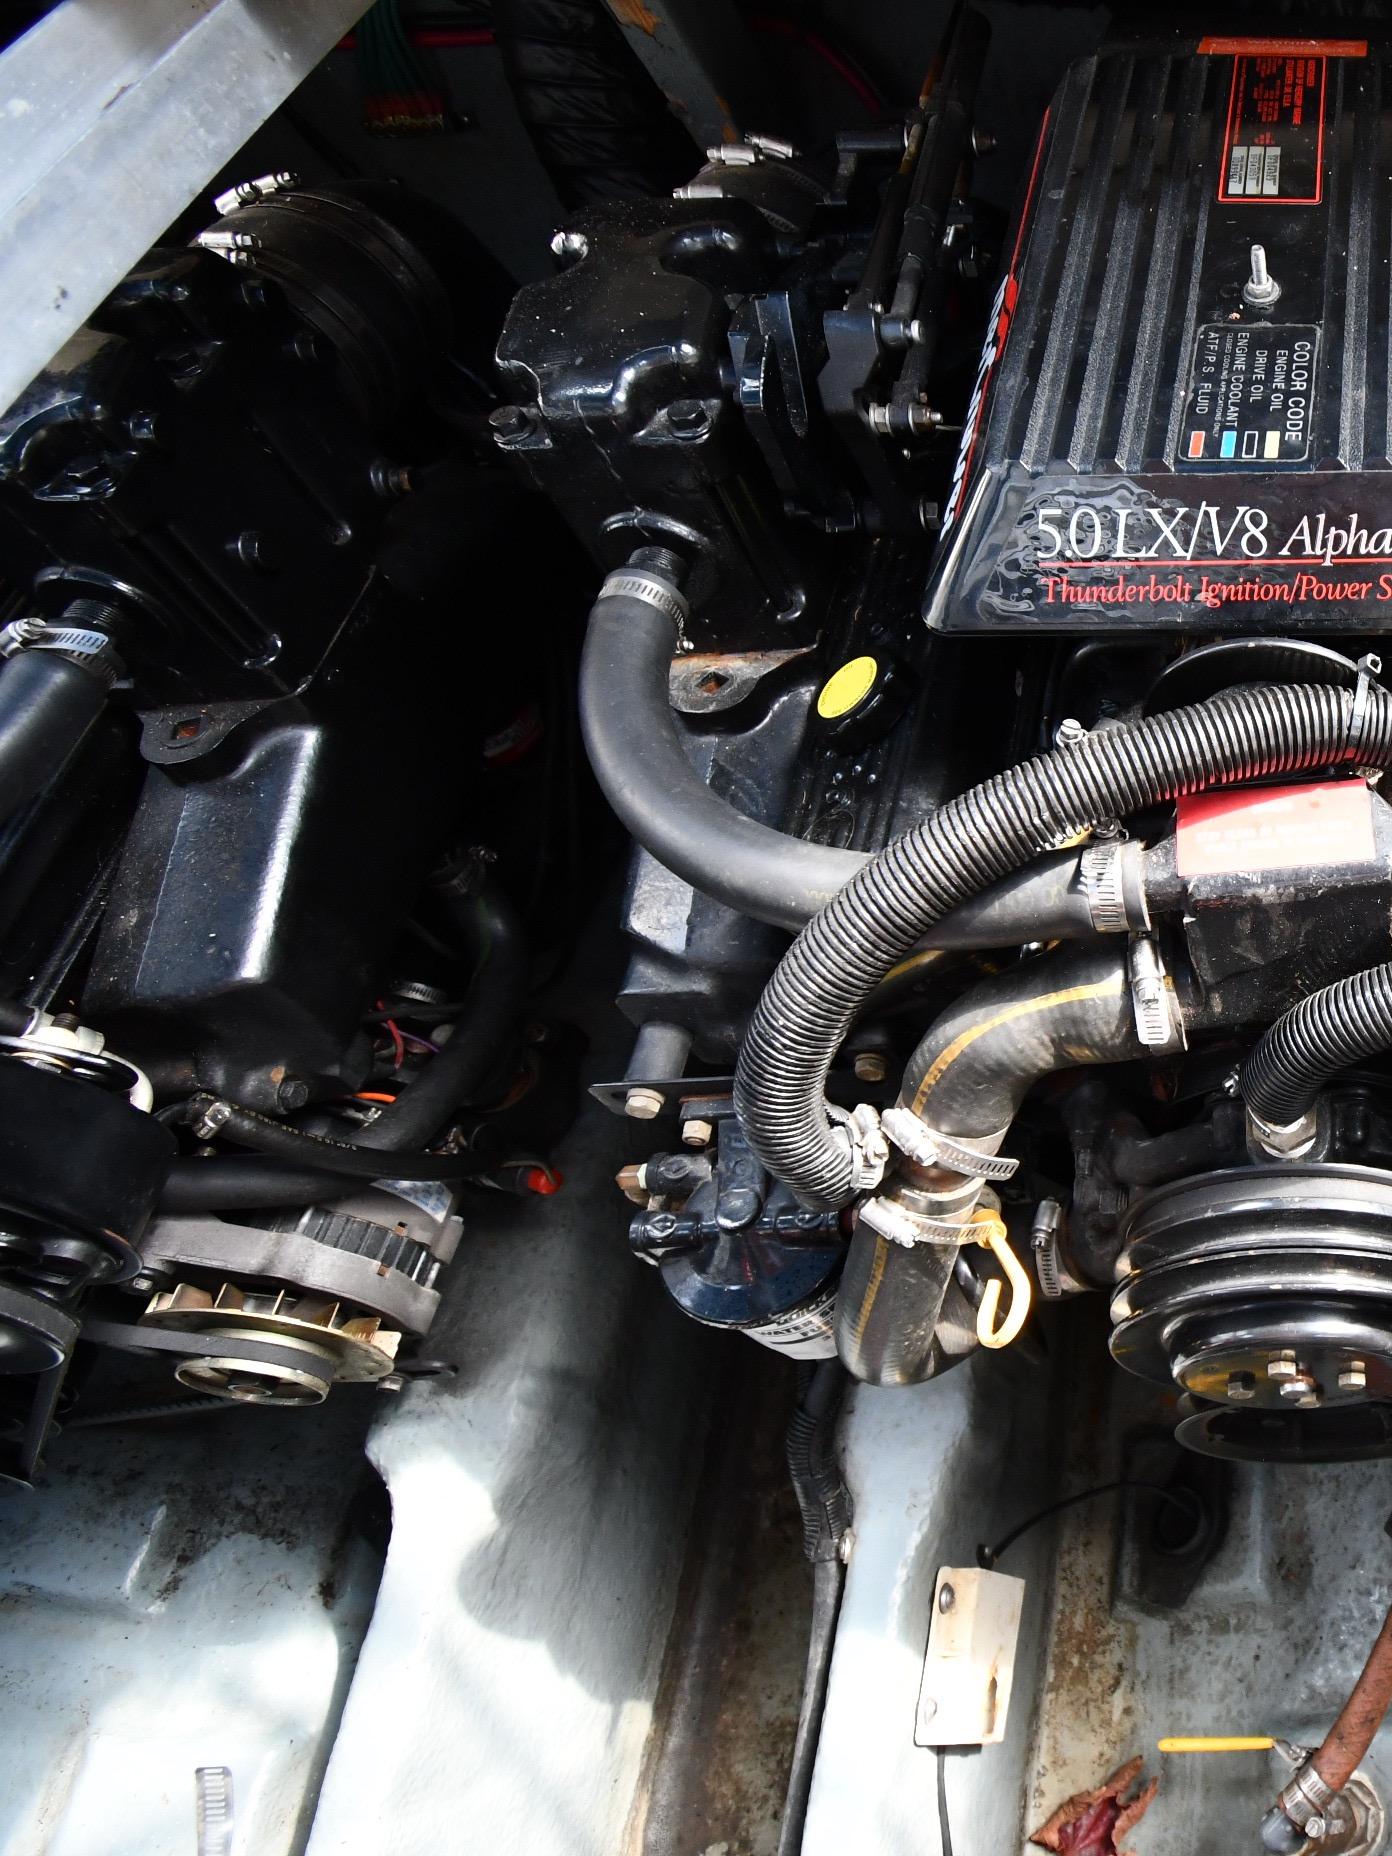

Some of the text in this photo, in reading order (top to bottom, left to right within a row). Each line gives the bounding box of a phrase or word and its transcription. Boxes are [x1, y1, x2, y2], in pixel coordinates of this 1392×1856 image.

[1196, 332, 1219, 414] ATF/P.S. FLUID
[1212, 333, 1233, 438] CLOSED COOLING APPLICATIONS ONLY
[1225, 332, 1249, 427] ENGINE COOLANT
[1250, 350, 1268, 403] DRIVE OIL
[1269, 350, 1288, 412] ENGINE OIL
[1285, 342, 1311, 441] COLOR CODE
[1041, 574, 1192, 603] Thunderbolt
[1201, 572, 1373, 608] Ignition/Power
